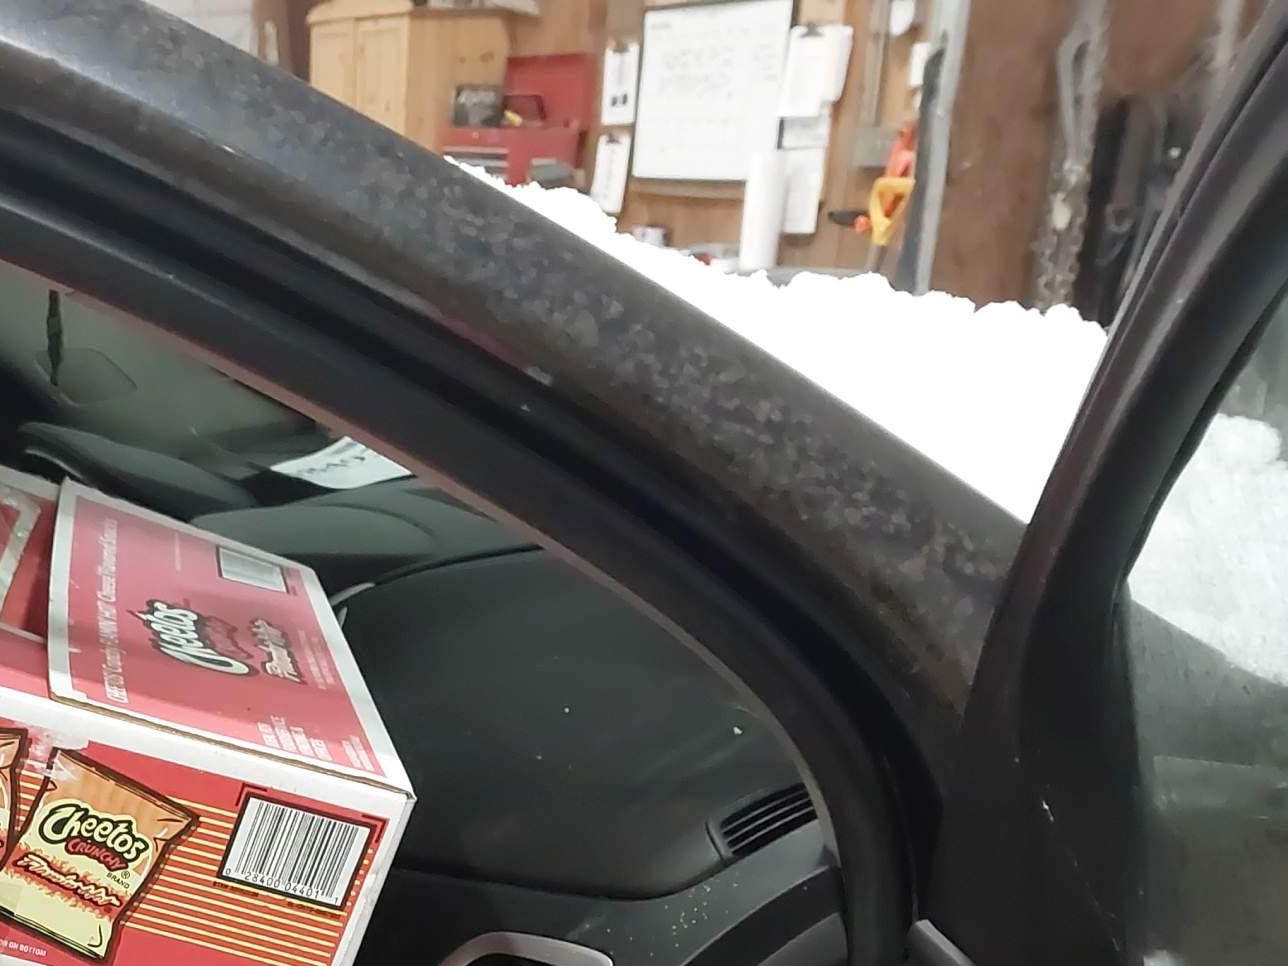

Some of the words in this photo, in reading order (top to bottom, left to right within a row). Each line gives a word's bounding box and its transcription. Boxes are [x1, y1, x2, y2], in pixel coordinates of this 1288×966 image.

[40, 803, 149, 862] Cheetos
[67, 837, 127, 871] CRUNCHY
[106, 871, 130, 889] BRAND
[225, 867, 232, 875] 0
[244, 871, 281, 889] 28400
[284, 881, 320, 899] 04401
[19, 943, 47, 957] BOTTOM
